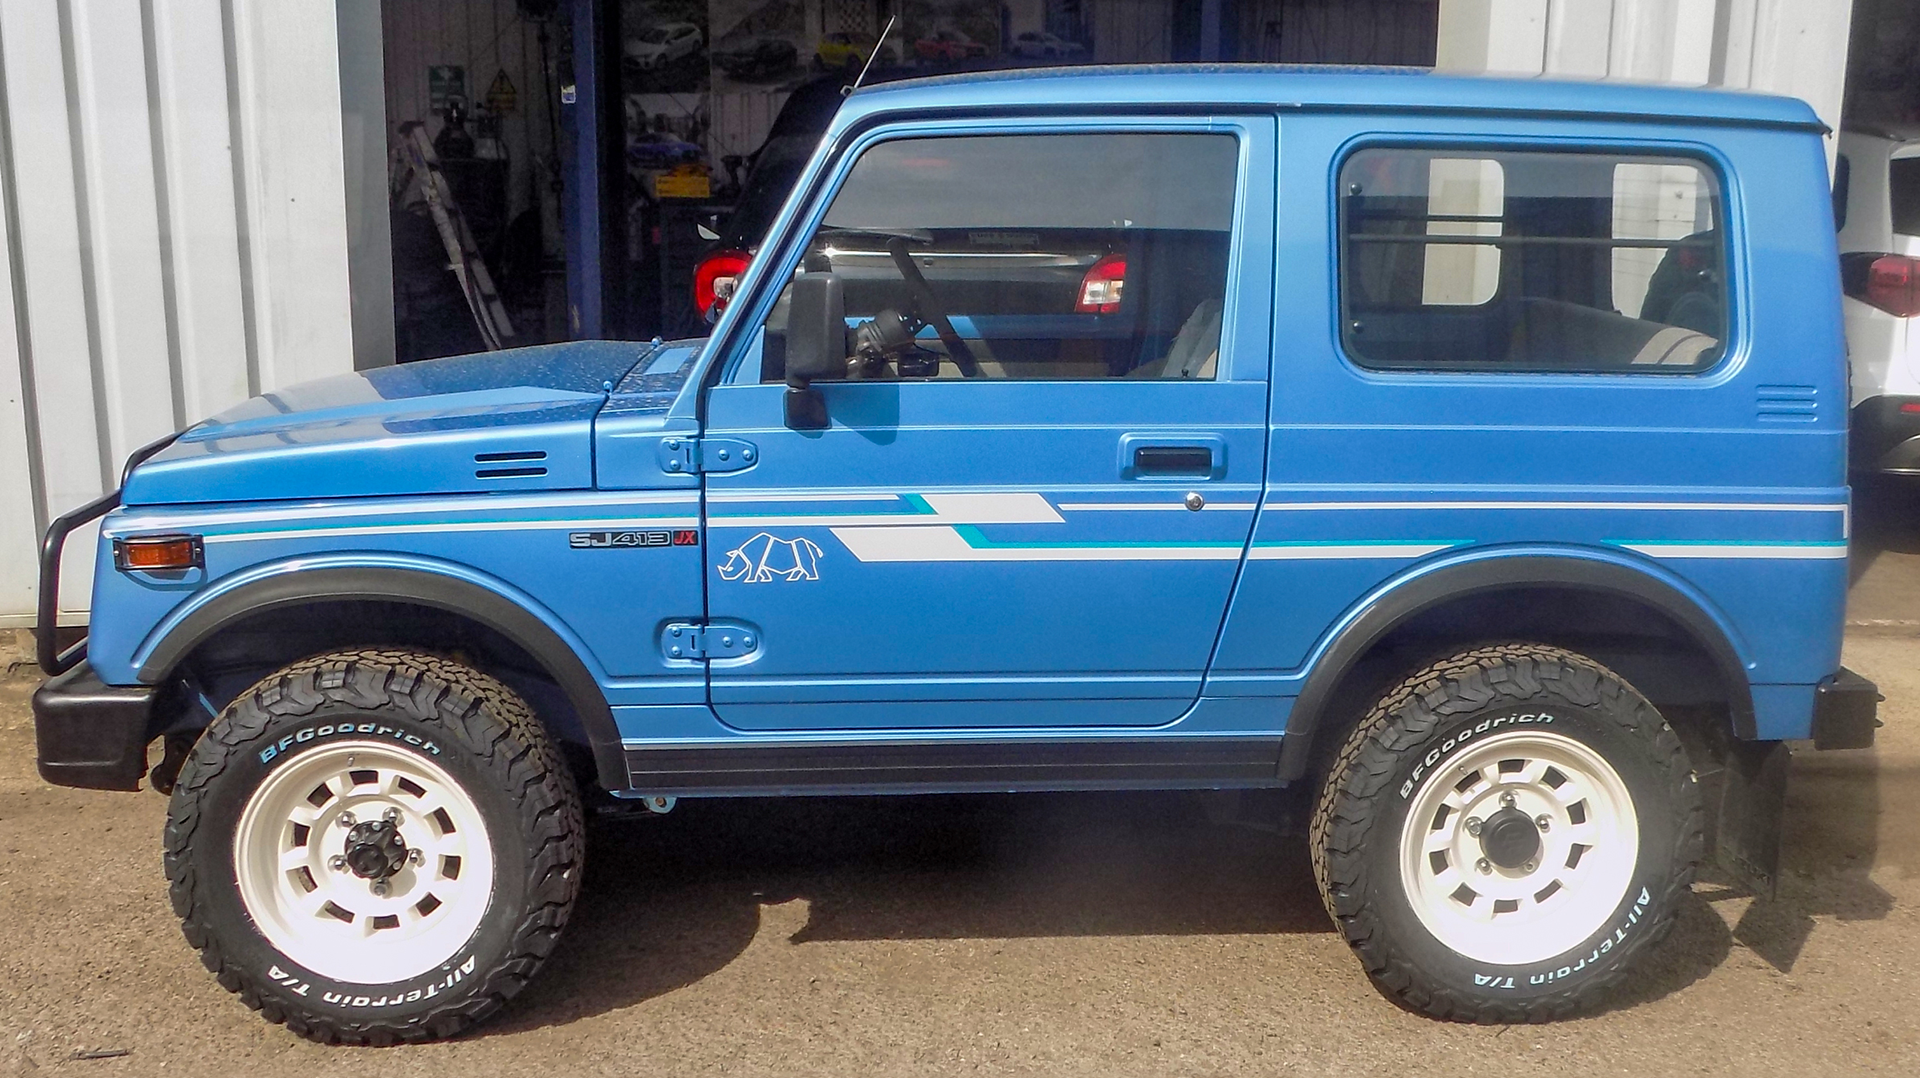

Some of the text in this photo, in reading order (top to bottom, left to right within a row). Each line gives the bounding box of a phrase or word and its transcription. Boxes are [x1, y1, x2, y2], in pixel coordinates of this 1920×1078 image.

[570, 531, 696, 547] SJ413 JX
[258, 722, 441, 764] BFGoodrich
[1399, 713, 1554, 799] BFGoodrich
[1474, 886, 1651, 989] All-Terrain T/A
[267, 955, 475, 1008] All-Terrain T/A
